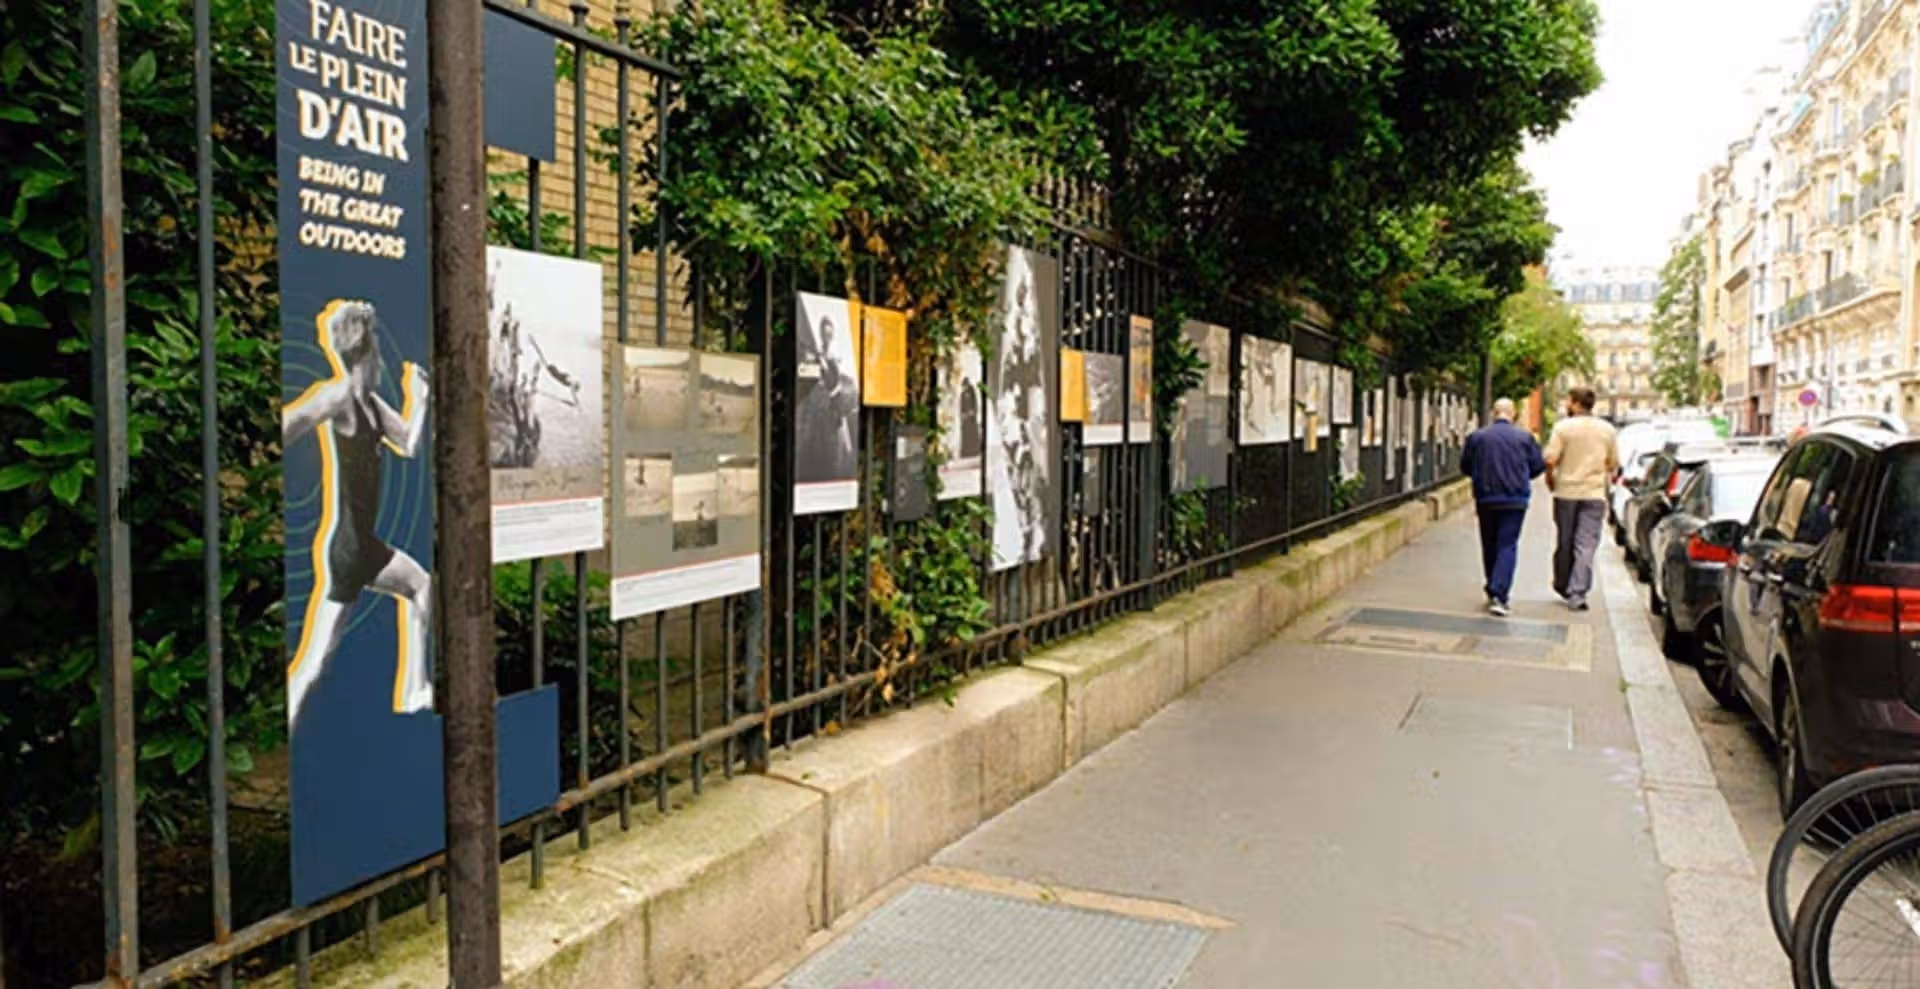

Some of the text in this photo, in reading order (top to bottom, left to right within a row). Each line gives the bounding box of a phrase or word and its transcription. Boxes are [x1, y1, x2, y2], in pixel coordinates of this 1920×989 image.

[308, 0, 408, 68] FAIRE
[288, 41, 408, 110] LE PLEIN
[296, 88, 409, 163] D'AIR
[299, 155, 386, 196] BEING IN
[299, 188, 404, 229] THE GREAT
[299, 221, 407, 260] OUTDOORS
